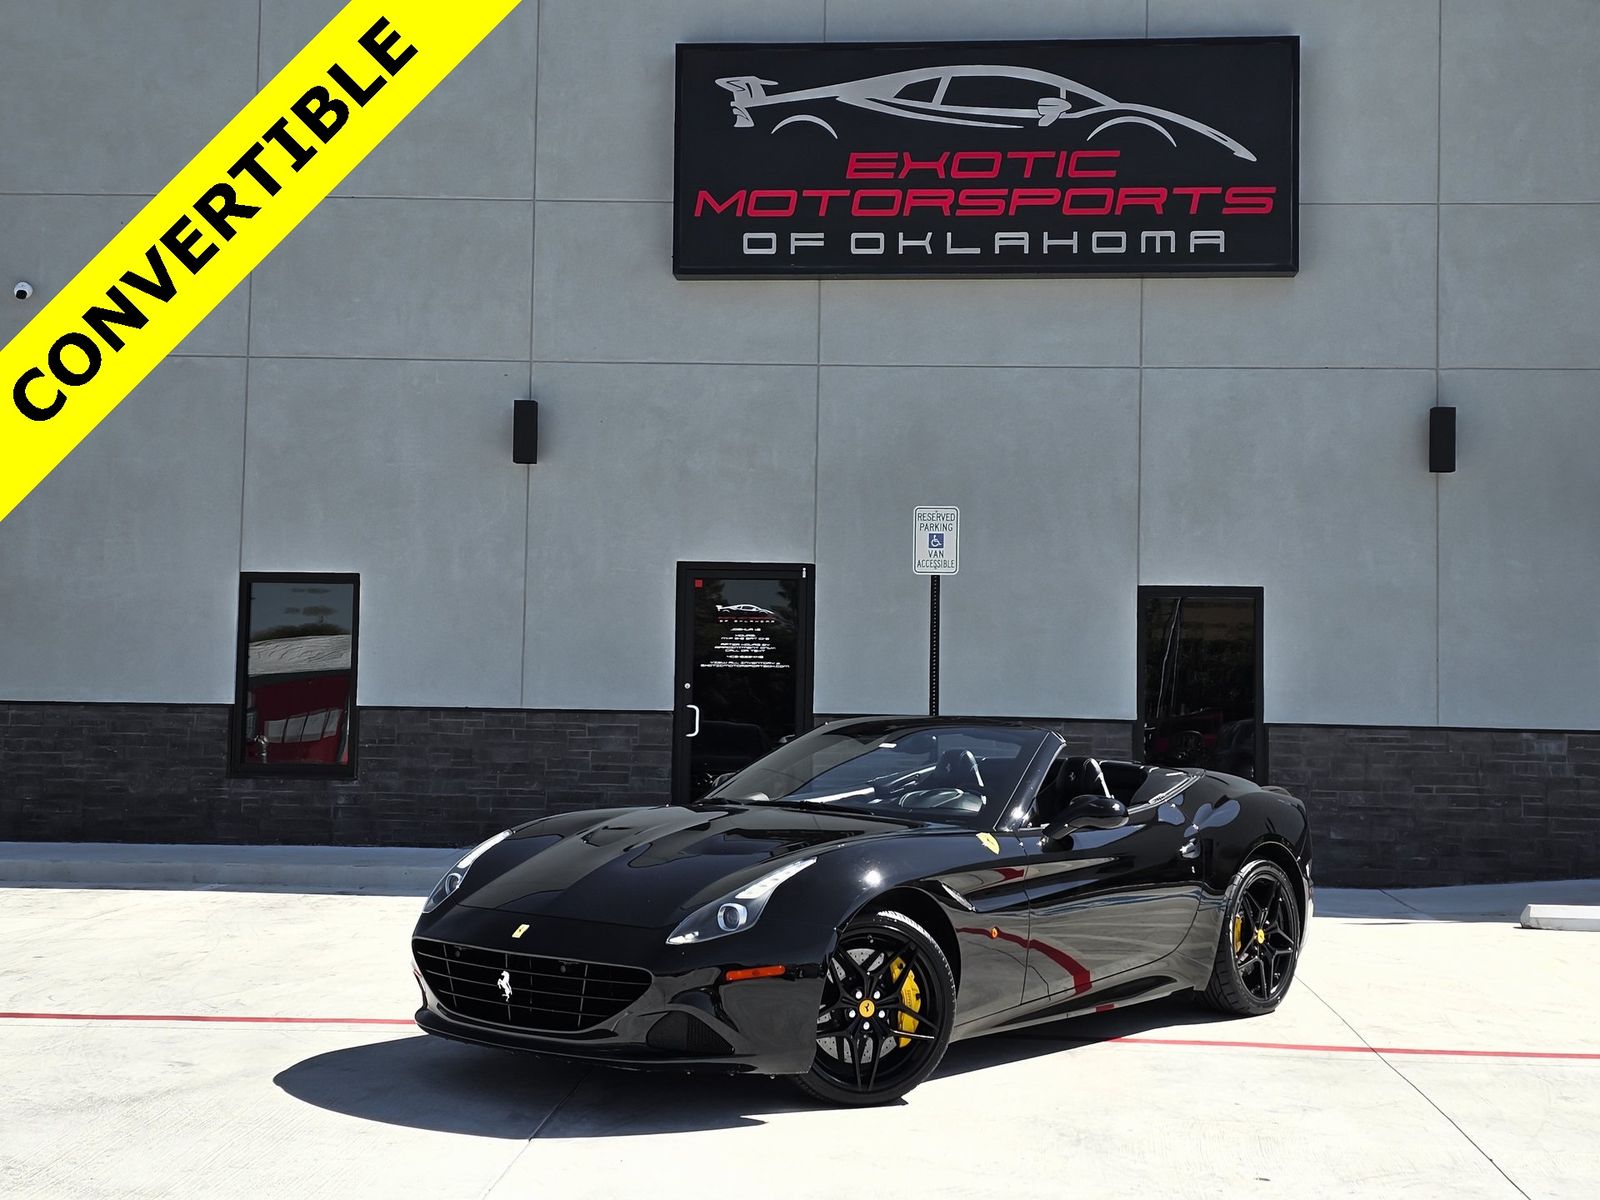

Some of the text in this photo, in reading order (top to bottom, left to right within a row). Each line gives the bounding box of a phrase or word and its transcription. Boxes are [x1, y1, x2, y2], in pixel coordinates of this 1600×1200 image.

[846, 150, 1121, 180] EXOTIC
[694, 186, 1276, 217] MOTORSPORTS
[742, 230, 1226, 255] OF OKLAHOMA
[918, 513, 955, 521] RESERVED
[919, 522, 953, 532] PARKING
[928, 550, 944, 558] VAN
[916, 559, 955, 568] ACCESSIBLE
